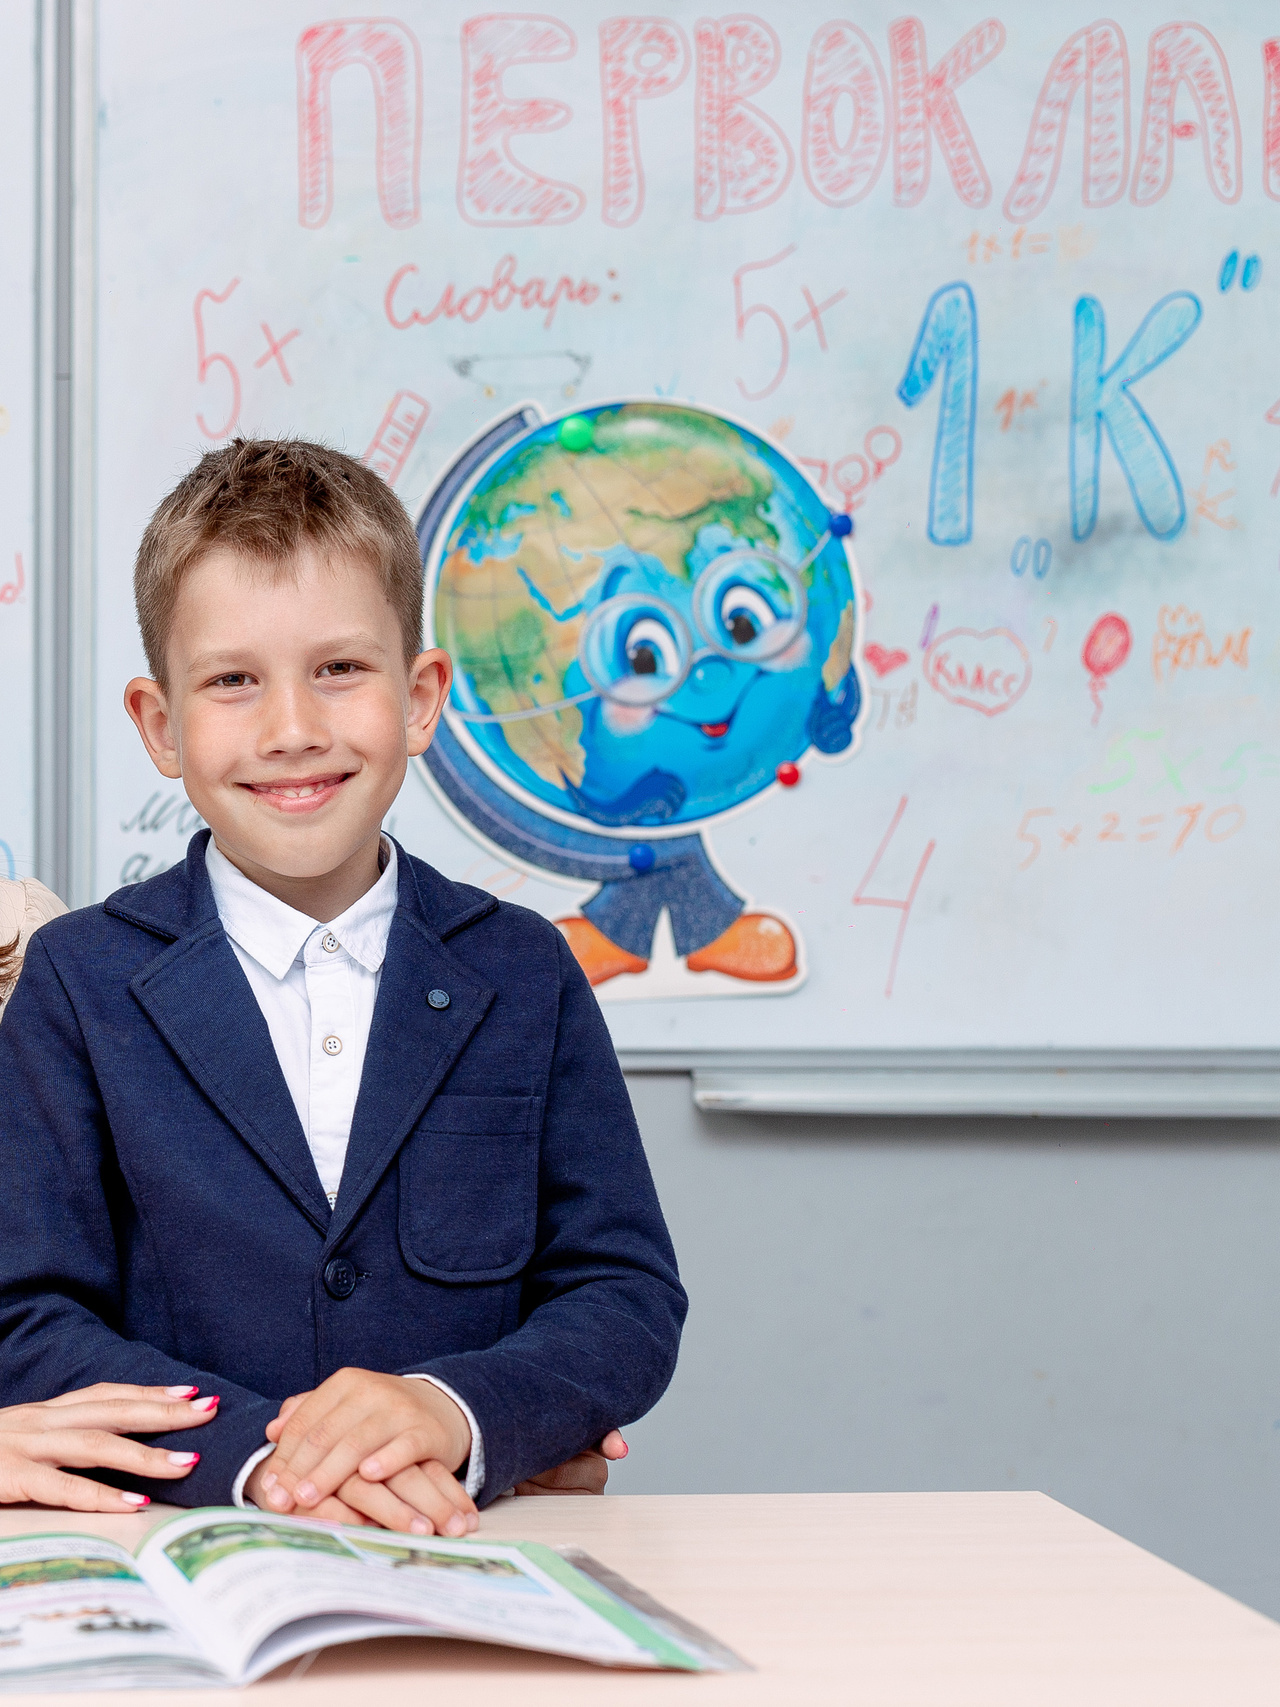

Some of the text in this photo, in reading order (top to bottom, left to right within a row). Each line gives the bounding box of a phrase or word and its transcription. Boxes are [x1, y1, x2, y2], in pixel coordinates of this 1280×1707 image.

[384, 253, 622, 331] Словарь:
[894, 279, 980, 549] 1
[851, 793, 937, 998] 4
